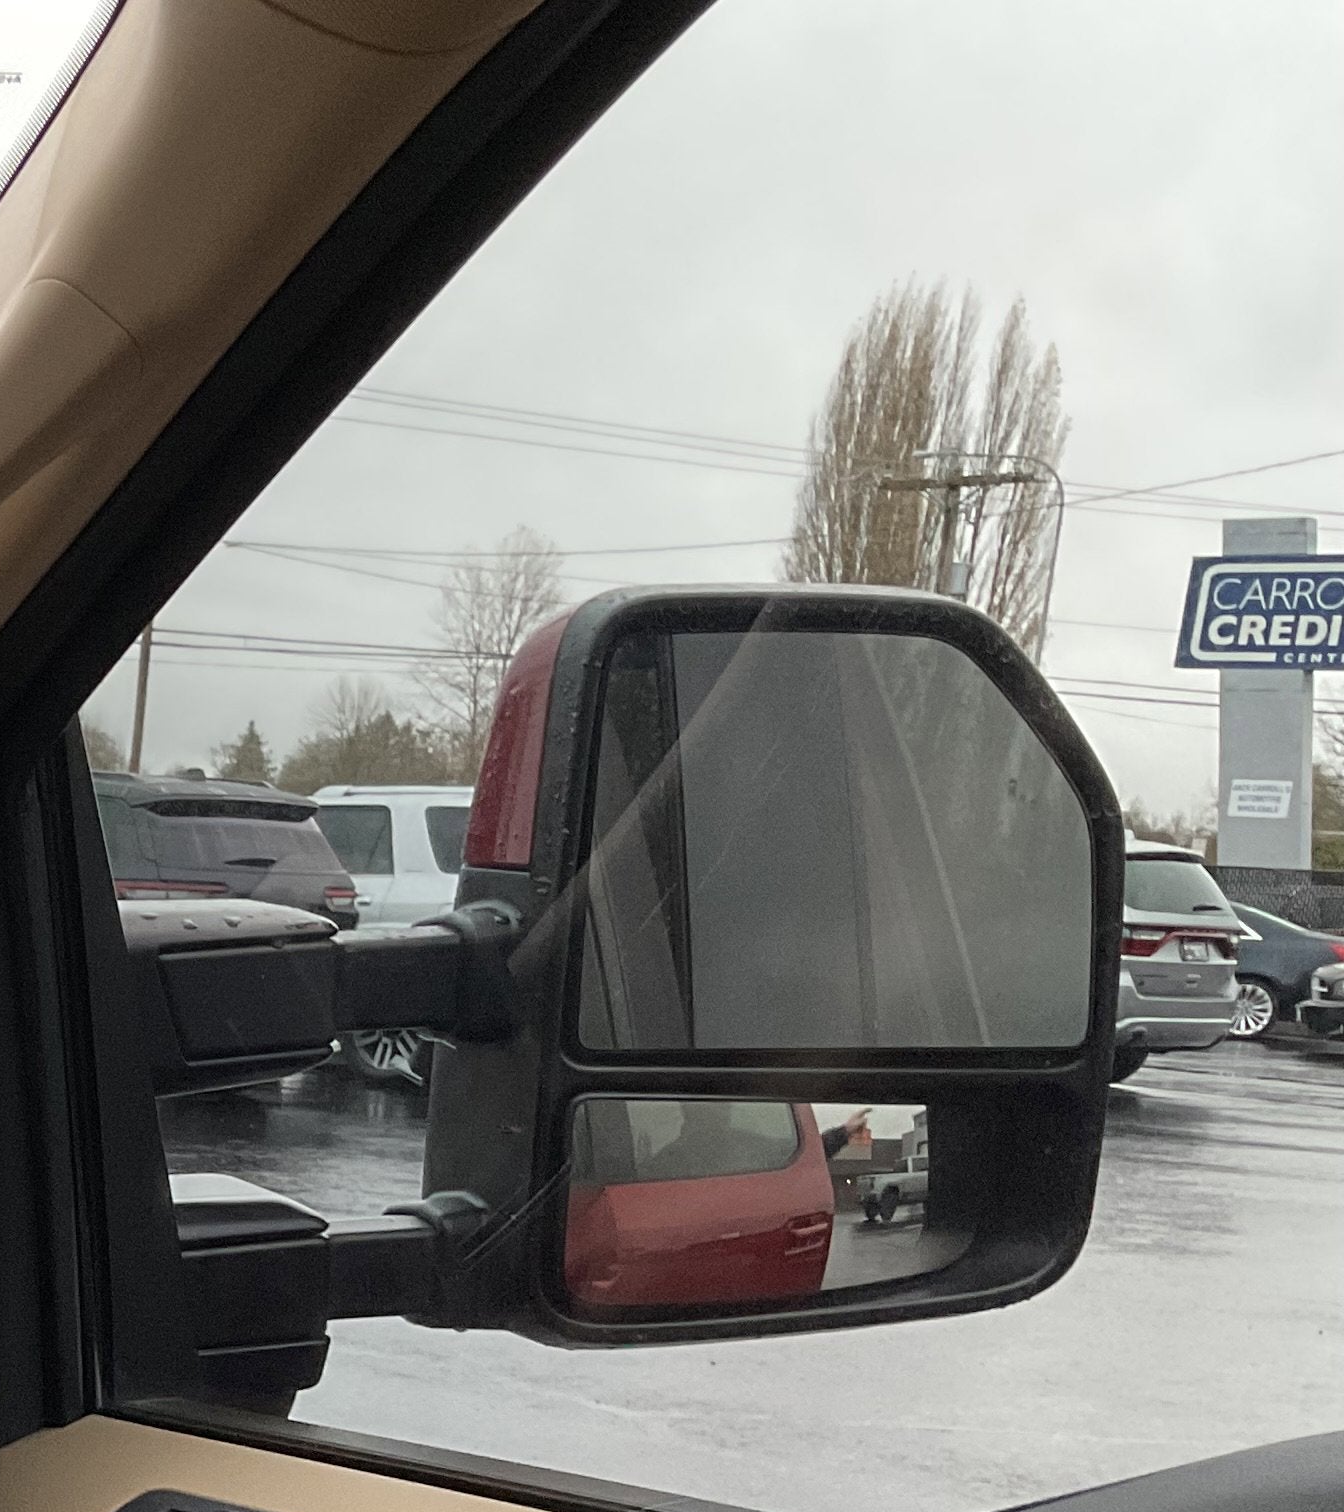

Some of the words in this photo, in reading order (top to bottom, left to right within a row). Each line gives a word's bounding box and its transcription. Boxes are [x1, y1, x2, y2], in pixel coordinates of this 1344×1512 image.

[1213, 578, 1344, 610] CARRO
[1208, 614, 1343, 646] CREDI
[1283, 653, 1344, 663] CENT
